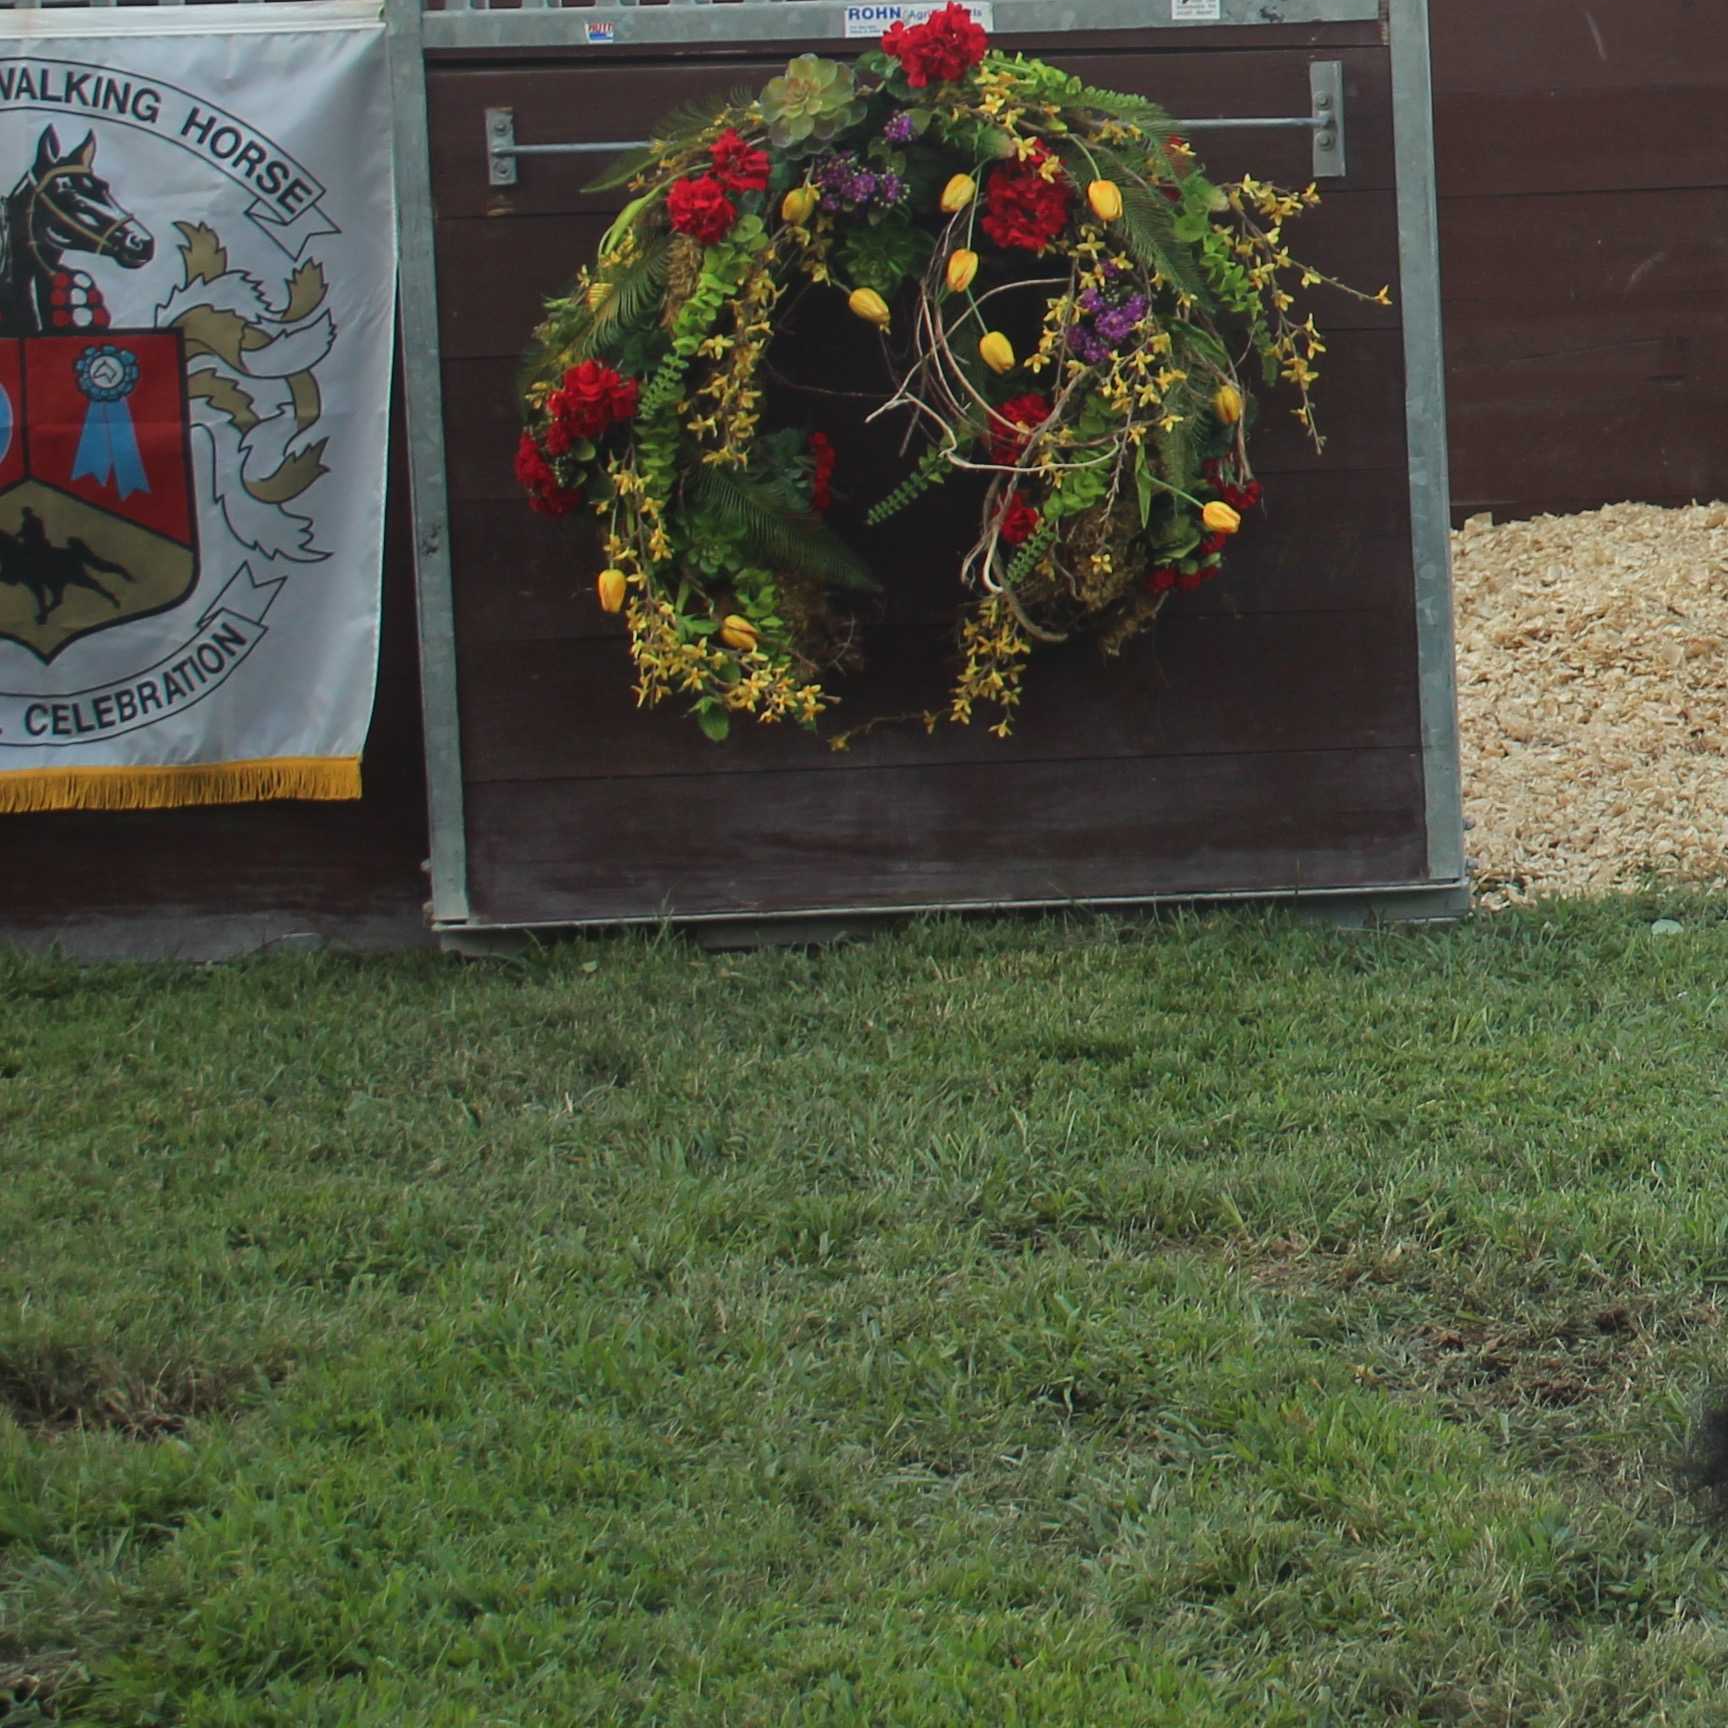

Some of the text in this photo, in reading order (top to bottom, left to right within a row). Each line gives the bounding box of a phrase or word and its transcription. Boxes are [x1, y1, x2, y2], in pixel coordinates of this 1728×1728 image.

[848, 6, 901, 20] ROHN
[180, 106, 313, 215] HORSE
[24, 622, 247, 737] CELEBRATION
